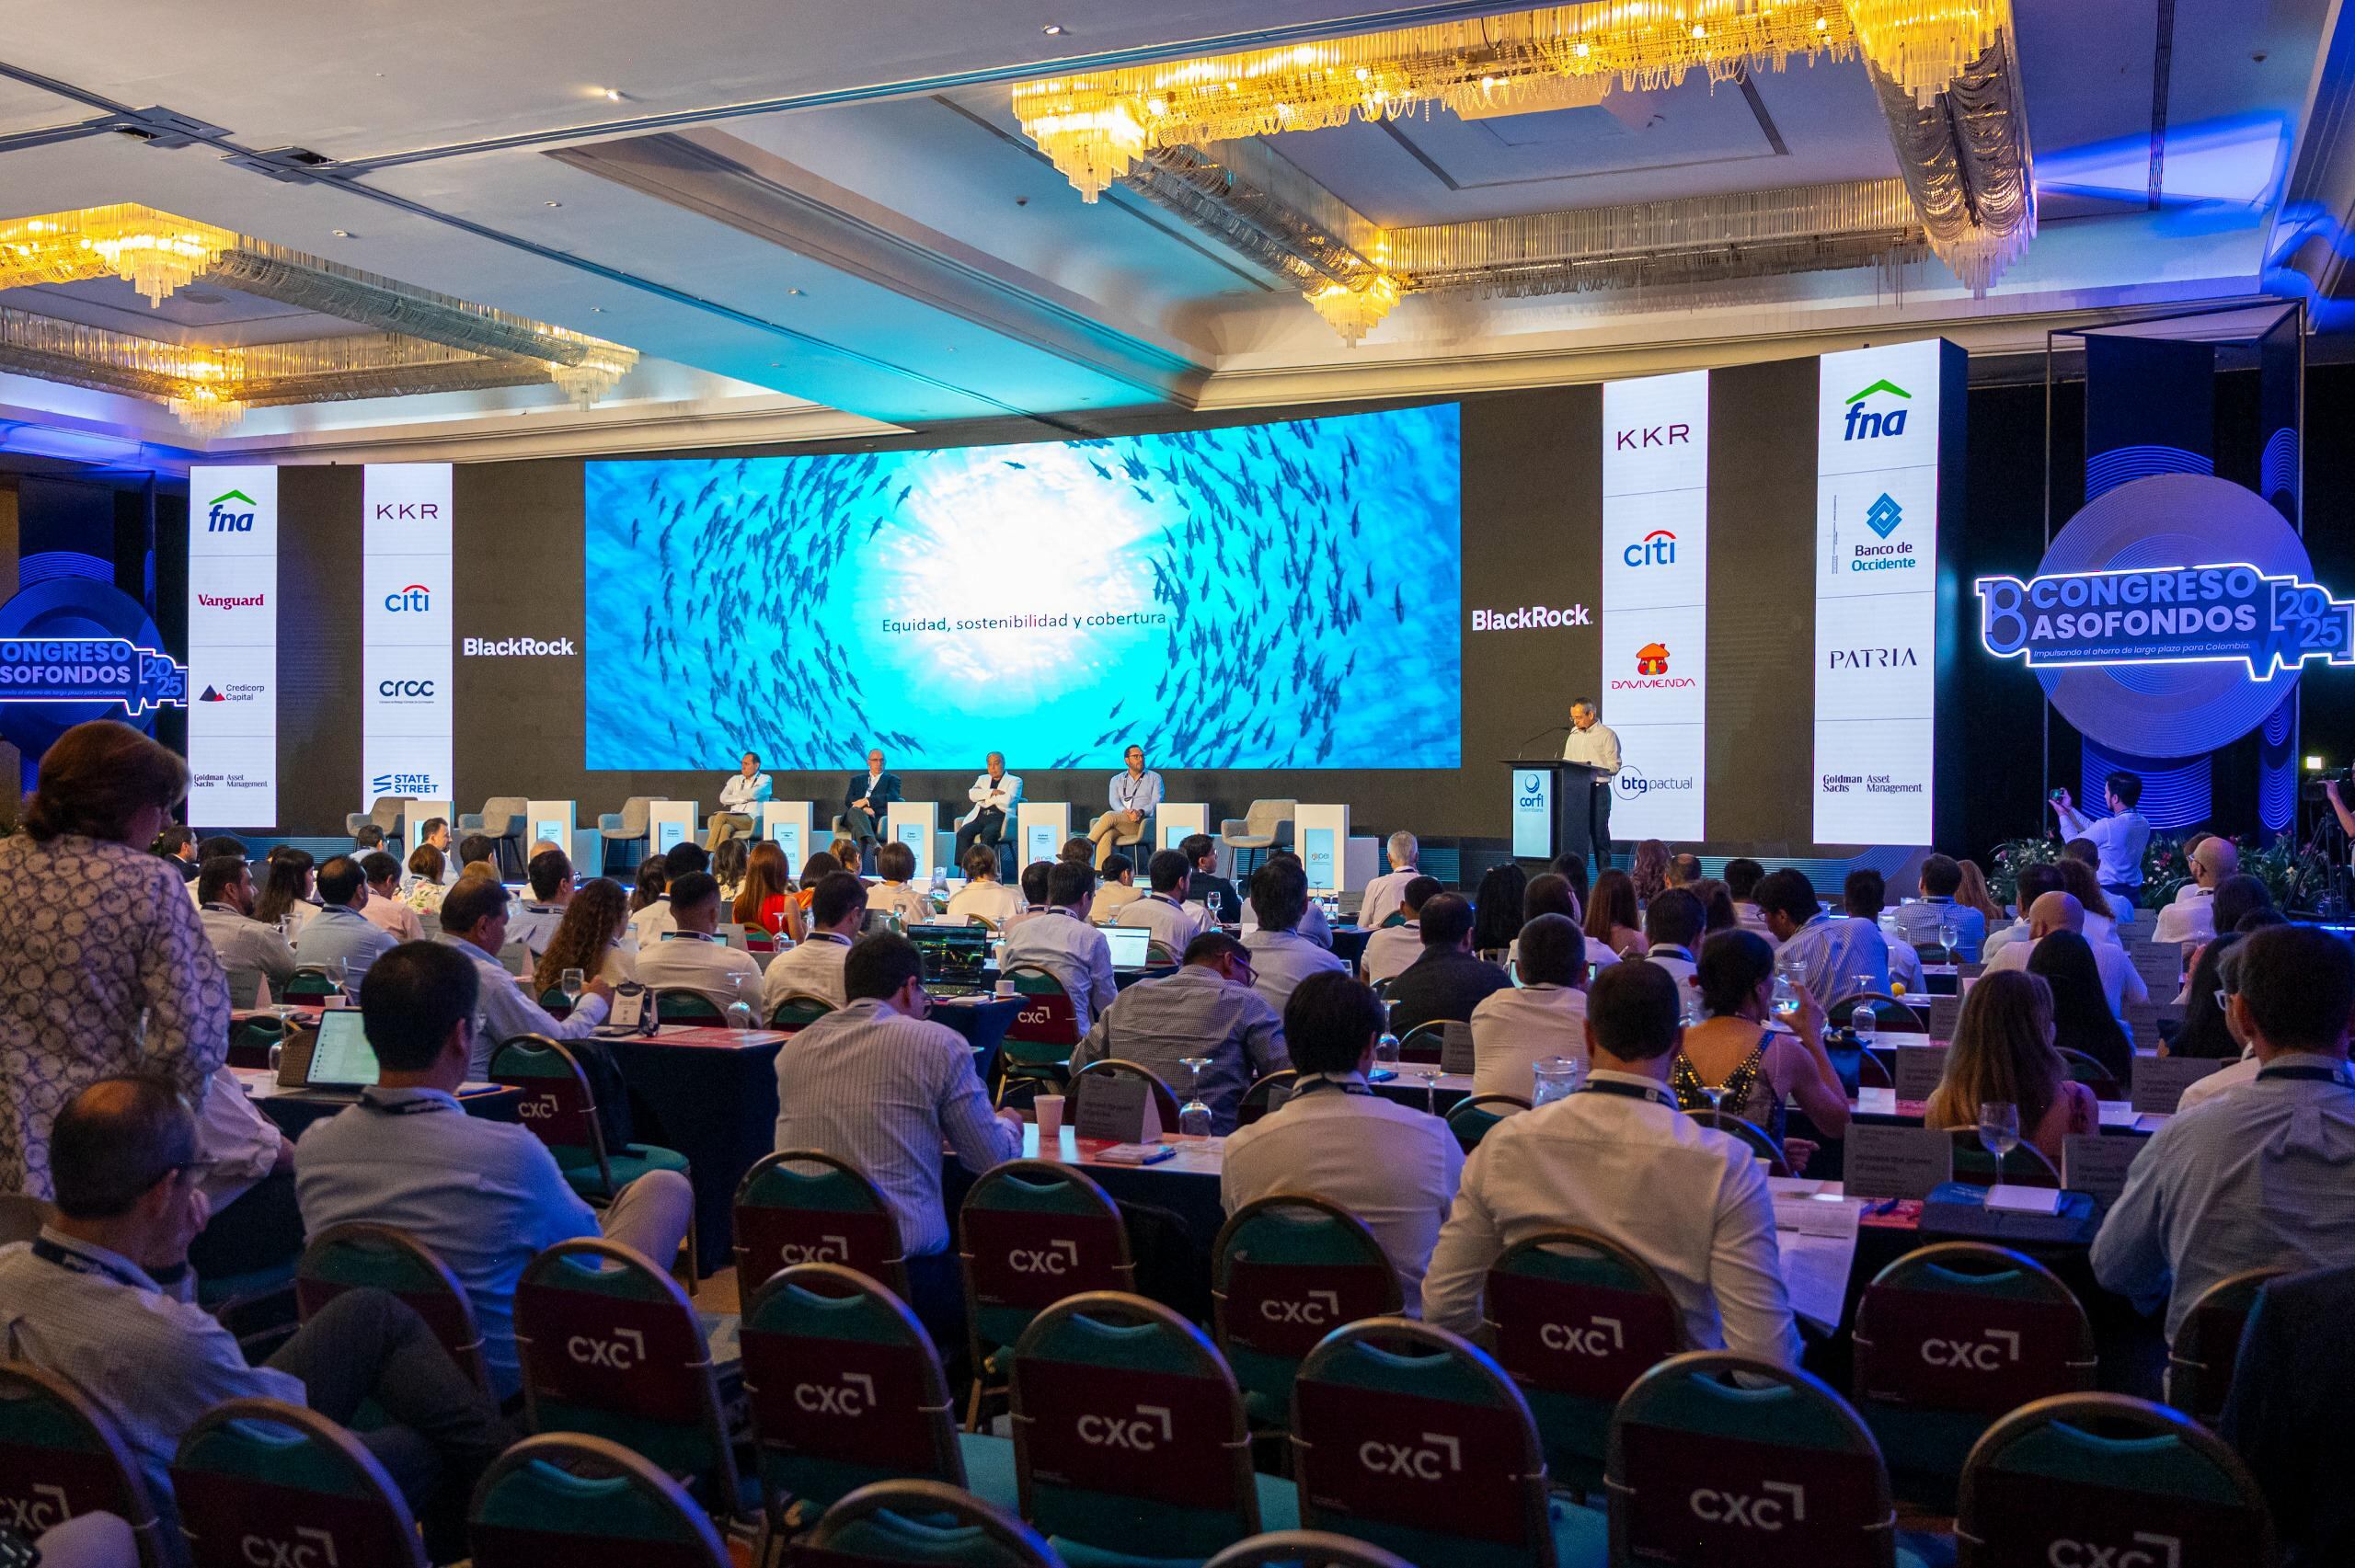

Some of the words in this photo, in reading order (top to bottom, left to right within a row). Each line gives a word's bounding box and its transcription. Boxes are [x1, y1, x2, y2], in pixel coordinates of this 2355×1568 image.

[1844, 402, 1908, 441] fna
[1617, 423, 1690, 451] KKR
[208, 504, 255, 532] fna
[376, 503, 438, 520] KKR
[1624, 537, 1675, 567] citi
[1855, 544, 1894, 556] Banco
[1897, 542, 1913, 554] de
[1851, 556, 1916, 572] Occidente
[2031, 567, 2257, 609] CONGRESO
[198, 594, 265, 610] Vanguard
[385, 589, 430, 612] citi
[882, 617, 951, 635] Equidad,
[957, 613, 1068, 630] sostenibilidad
[1073, 615, 1083, 629] y
[1086, 611, 1166, 626] cobertura
[2030, 604, 2257, 641] ASOFONDOS
[1831, 647, 1918, 669] PATRIA
[2034, 648, 2082, 658] Impulsando
[2134, 646, 2156, 656] largo
[2158, 645, 2181, 654] plazo
[2182, 644, 2204, 653] para
[225, 684, 265, 692] Credicorp
[1611, 678, 1695, 690] DAVIVIENDA
[225, 693, 254, 702] Capital
[395, 774, 430, 784] STATE
[1823, 774, 1863, 784] Goldman
[1867, 774, 1890, 784] Asset
[395, 784, 439, 793] STREET
[1823, 784, 1850, 793] Sachs
[1867, 783, 1923, 795] Management
[1520, 793, 1544, 807] corfi
